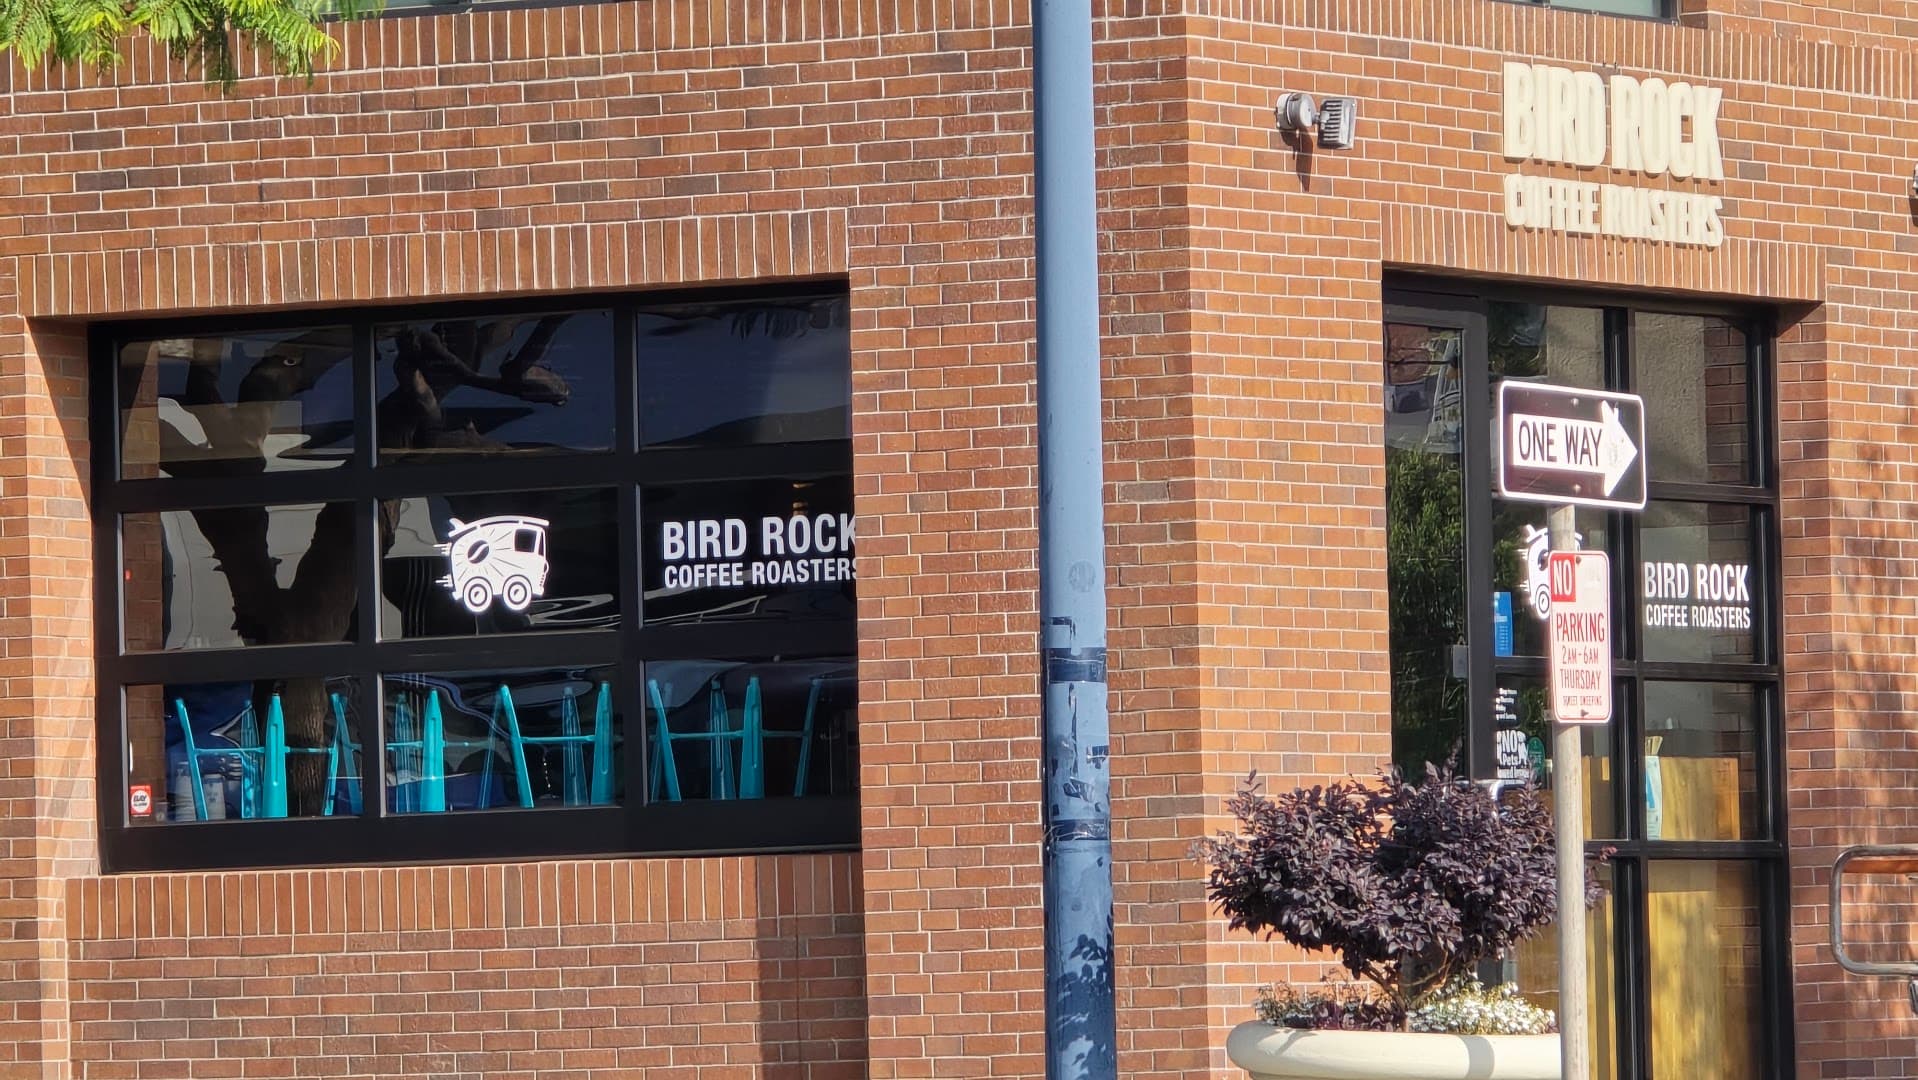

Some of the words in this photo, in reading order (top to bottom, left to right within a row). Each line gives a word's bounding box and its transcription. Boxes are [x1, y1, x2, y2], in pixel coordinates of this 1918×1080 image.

[1503, 61, 1607, 168] BIRD
[1610, 75, 1724, 182] ROCK
[1503, 174, 1601, 235] COFFEE
[1601, 183, 1724, 247] ROASTERS
[1518, 420, 1558, 463] ONE
[1564, 424, 1602, 467] WAY
[662, 518, 748, 560] BIRD
[762, 512, 857, 557] ROCK
[664, 563, 744, 589] COFFEE
[1553, 559, 1573, 596] NO
[1643, 562, 1690, 599] BIRD
[1695, 563, 1750, 602] ROCK
[1556, 612, 1606, 643] PARKING
[1646, 603, 1689, 627] COFFEE
[1691, 605, 1751, 629] ROASTERS
[1559, 668, 1601, 690] THURSDAY
[1501, 729, 1518, 753] NO
